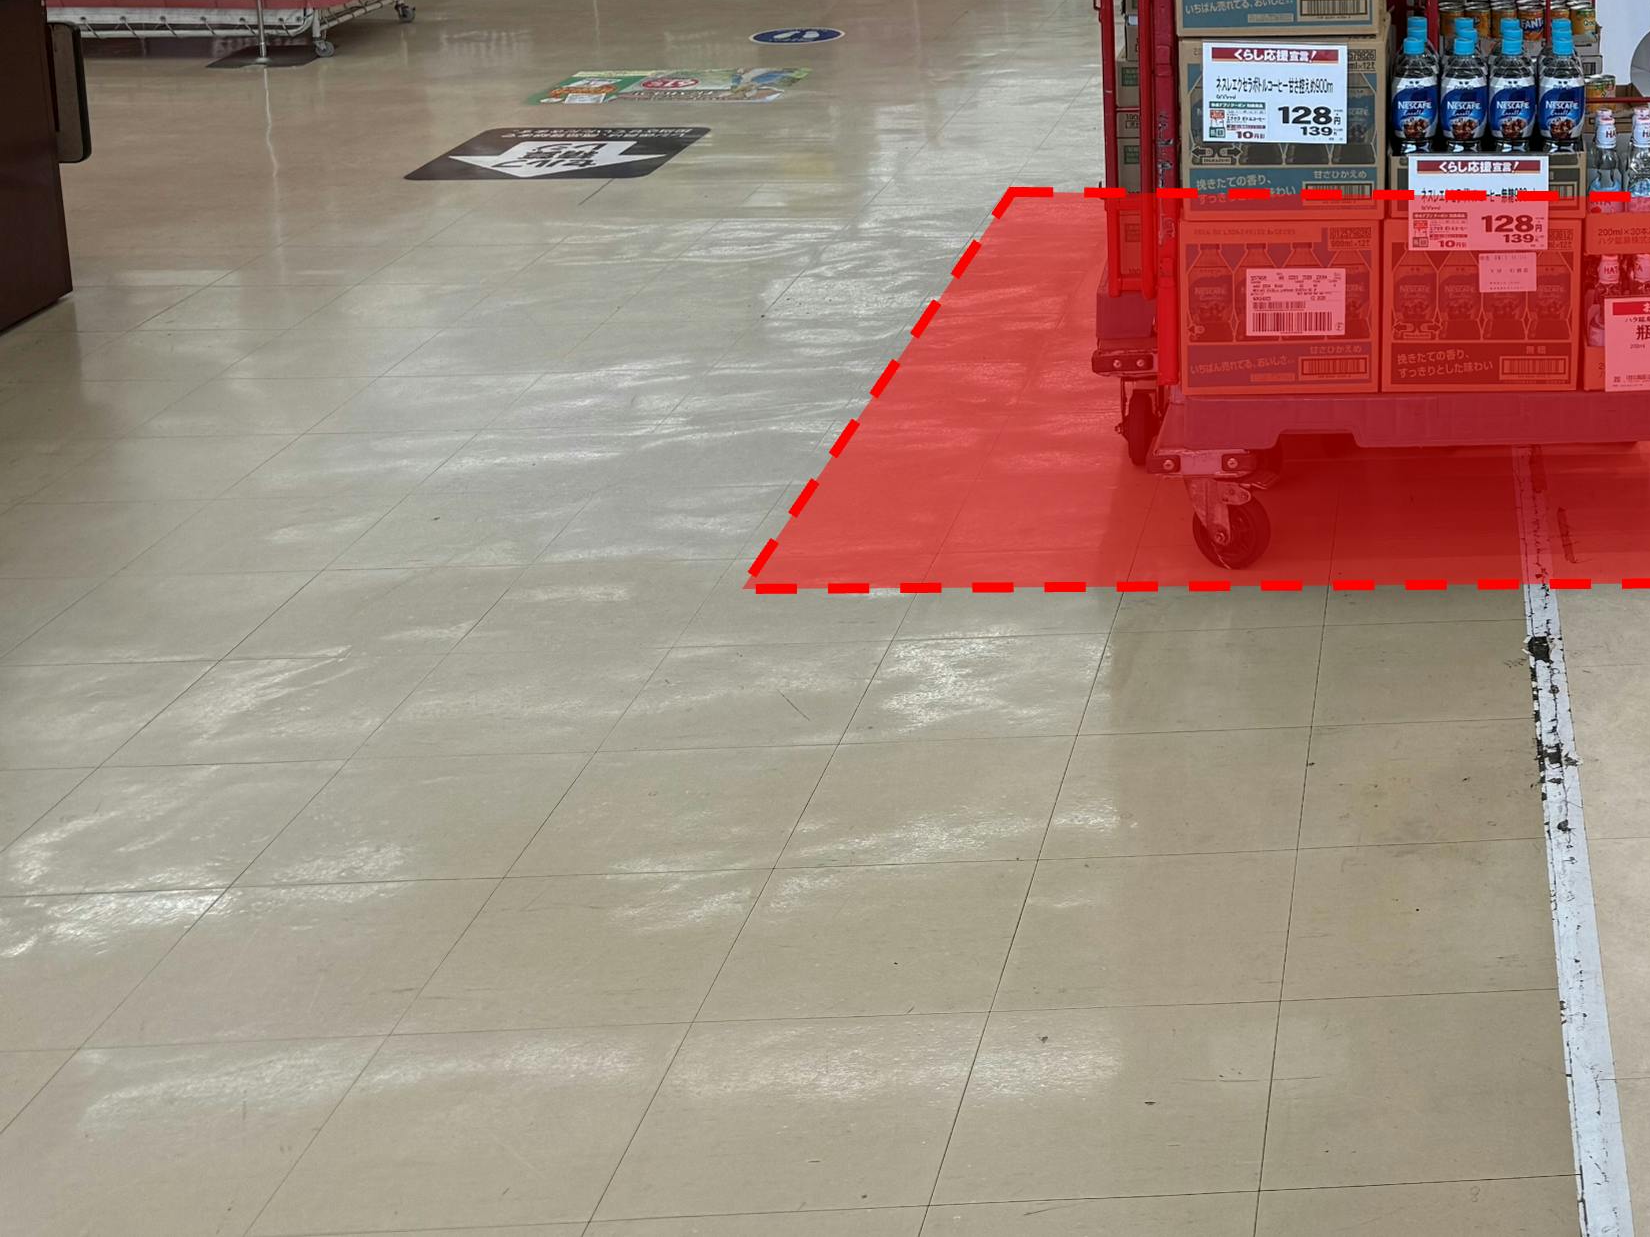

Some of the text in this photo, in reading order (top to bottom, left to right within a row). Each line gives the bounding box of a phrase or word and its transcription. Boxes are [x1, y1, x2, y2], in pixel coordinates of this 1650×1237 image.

[1234, 49, 1317, 62] くらし応援宣言!
[1278, 106, 1332, 125] 128
[1301, 126, 1333, 136] 139
[1439, 161, 1519, 173] くらし応援宣言!
[1313, 170, 1368, 180] 甘さひかえめ
